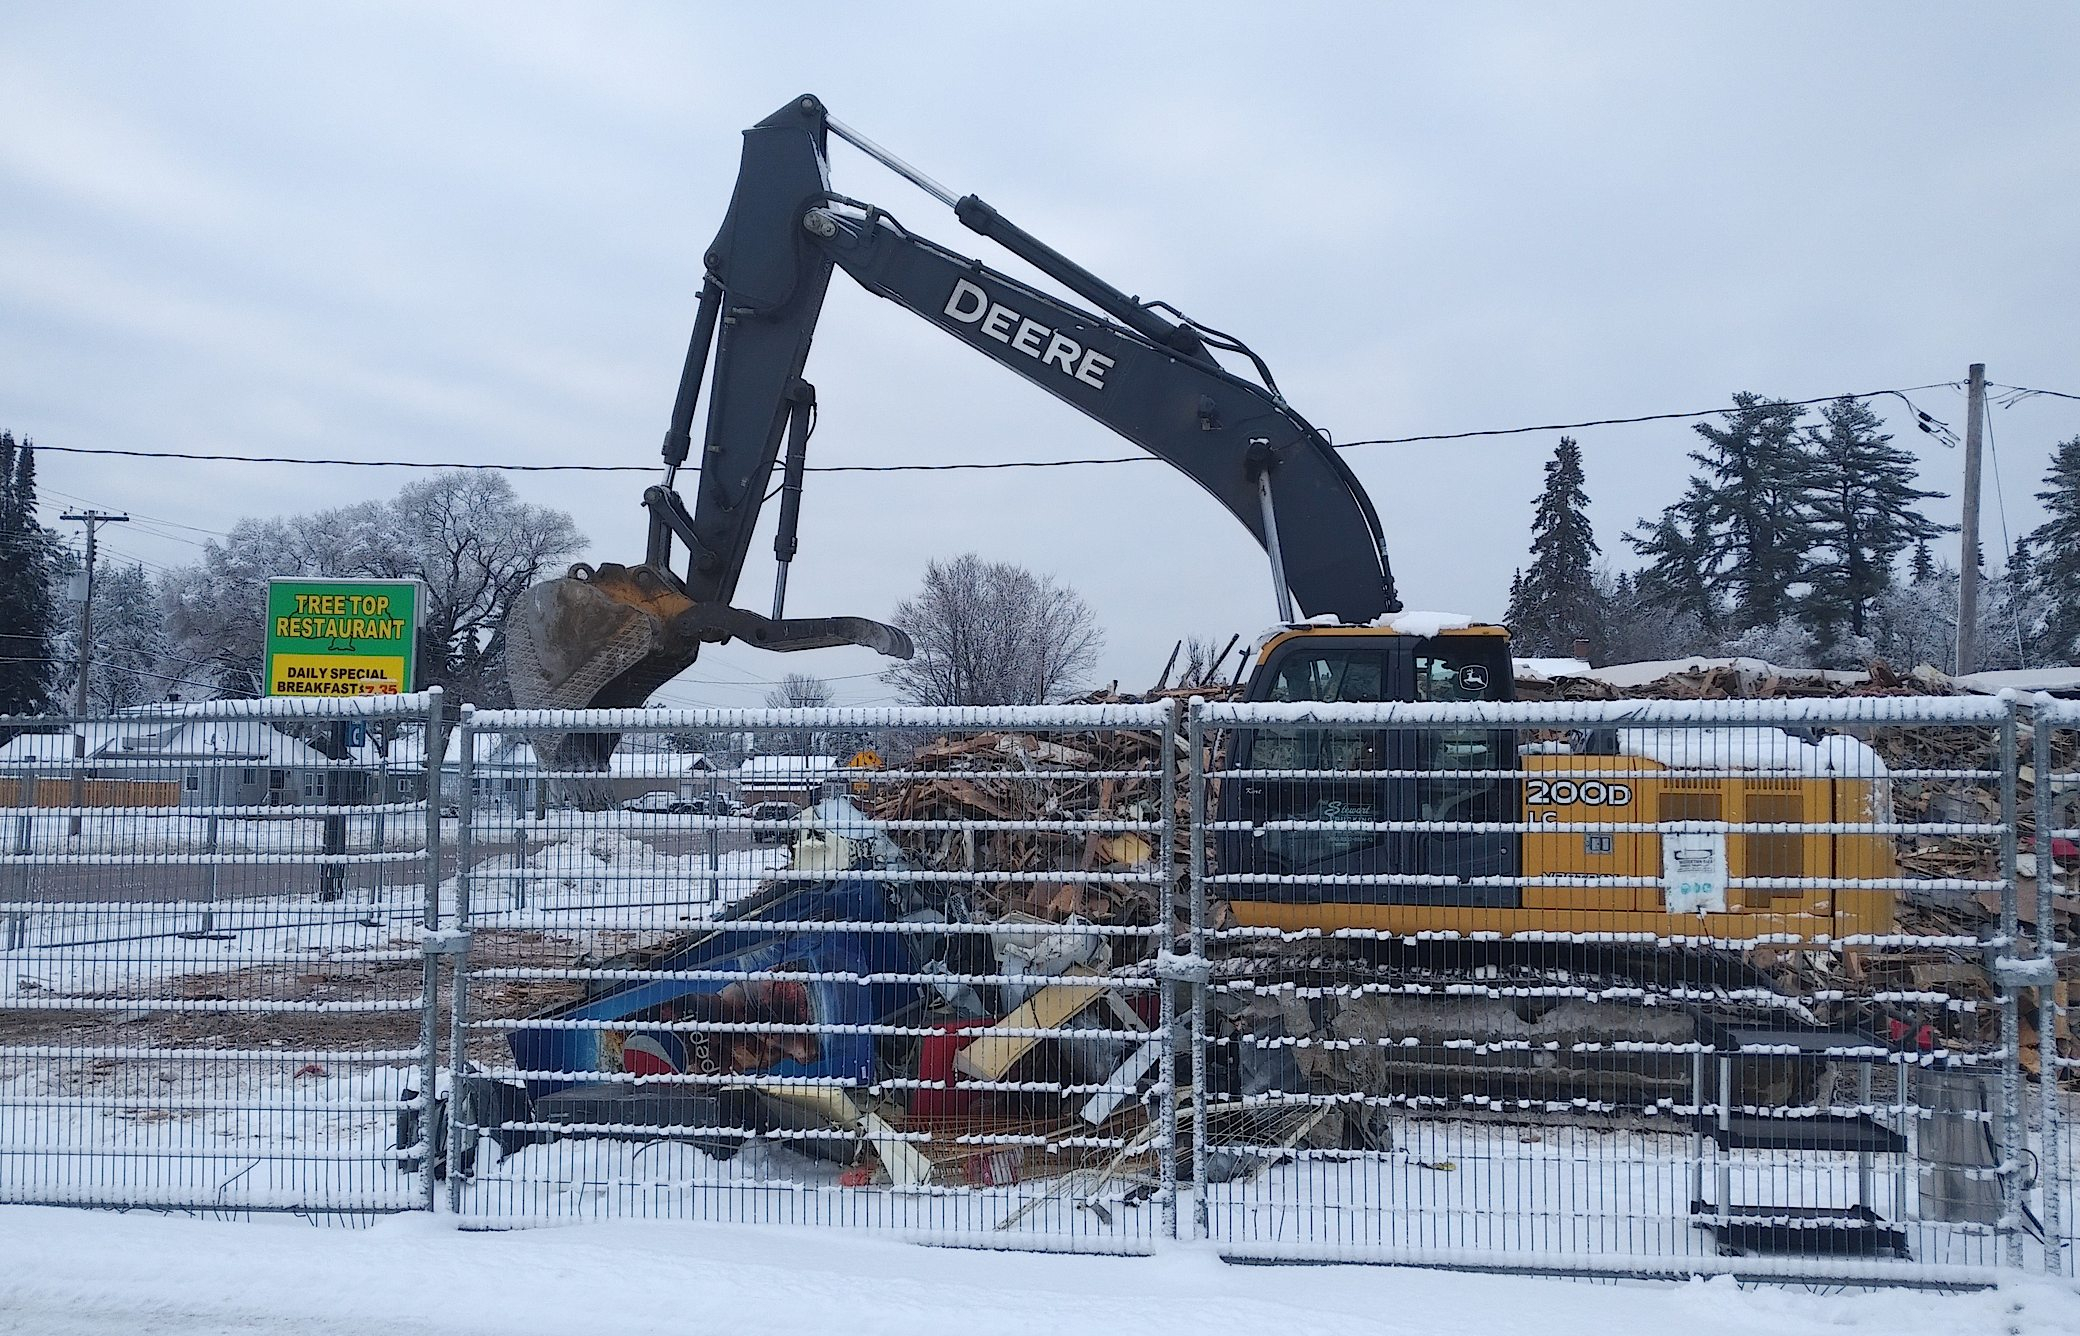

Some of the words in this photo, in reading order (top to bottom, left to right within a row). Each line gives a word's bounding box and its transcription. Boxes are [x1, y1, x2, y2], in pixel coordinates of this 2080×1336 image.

[943, 277, 1116, 390] DEERE
[295, 594, 346, 615] TREE
[349, 596, 389, 616] TOP
[276, 616, 405, 640] RESTAURANT
[287, 667, 327, 679] DAILY
[330, 668, 388, 680] SPECIAL
[277, 681, 358, 695] BREAKFAST
[1526, 779, 1632, 806] 200D
[1528, 811, 1558, 823] LC
